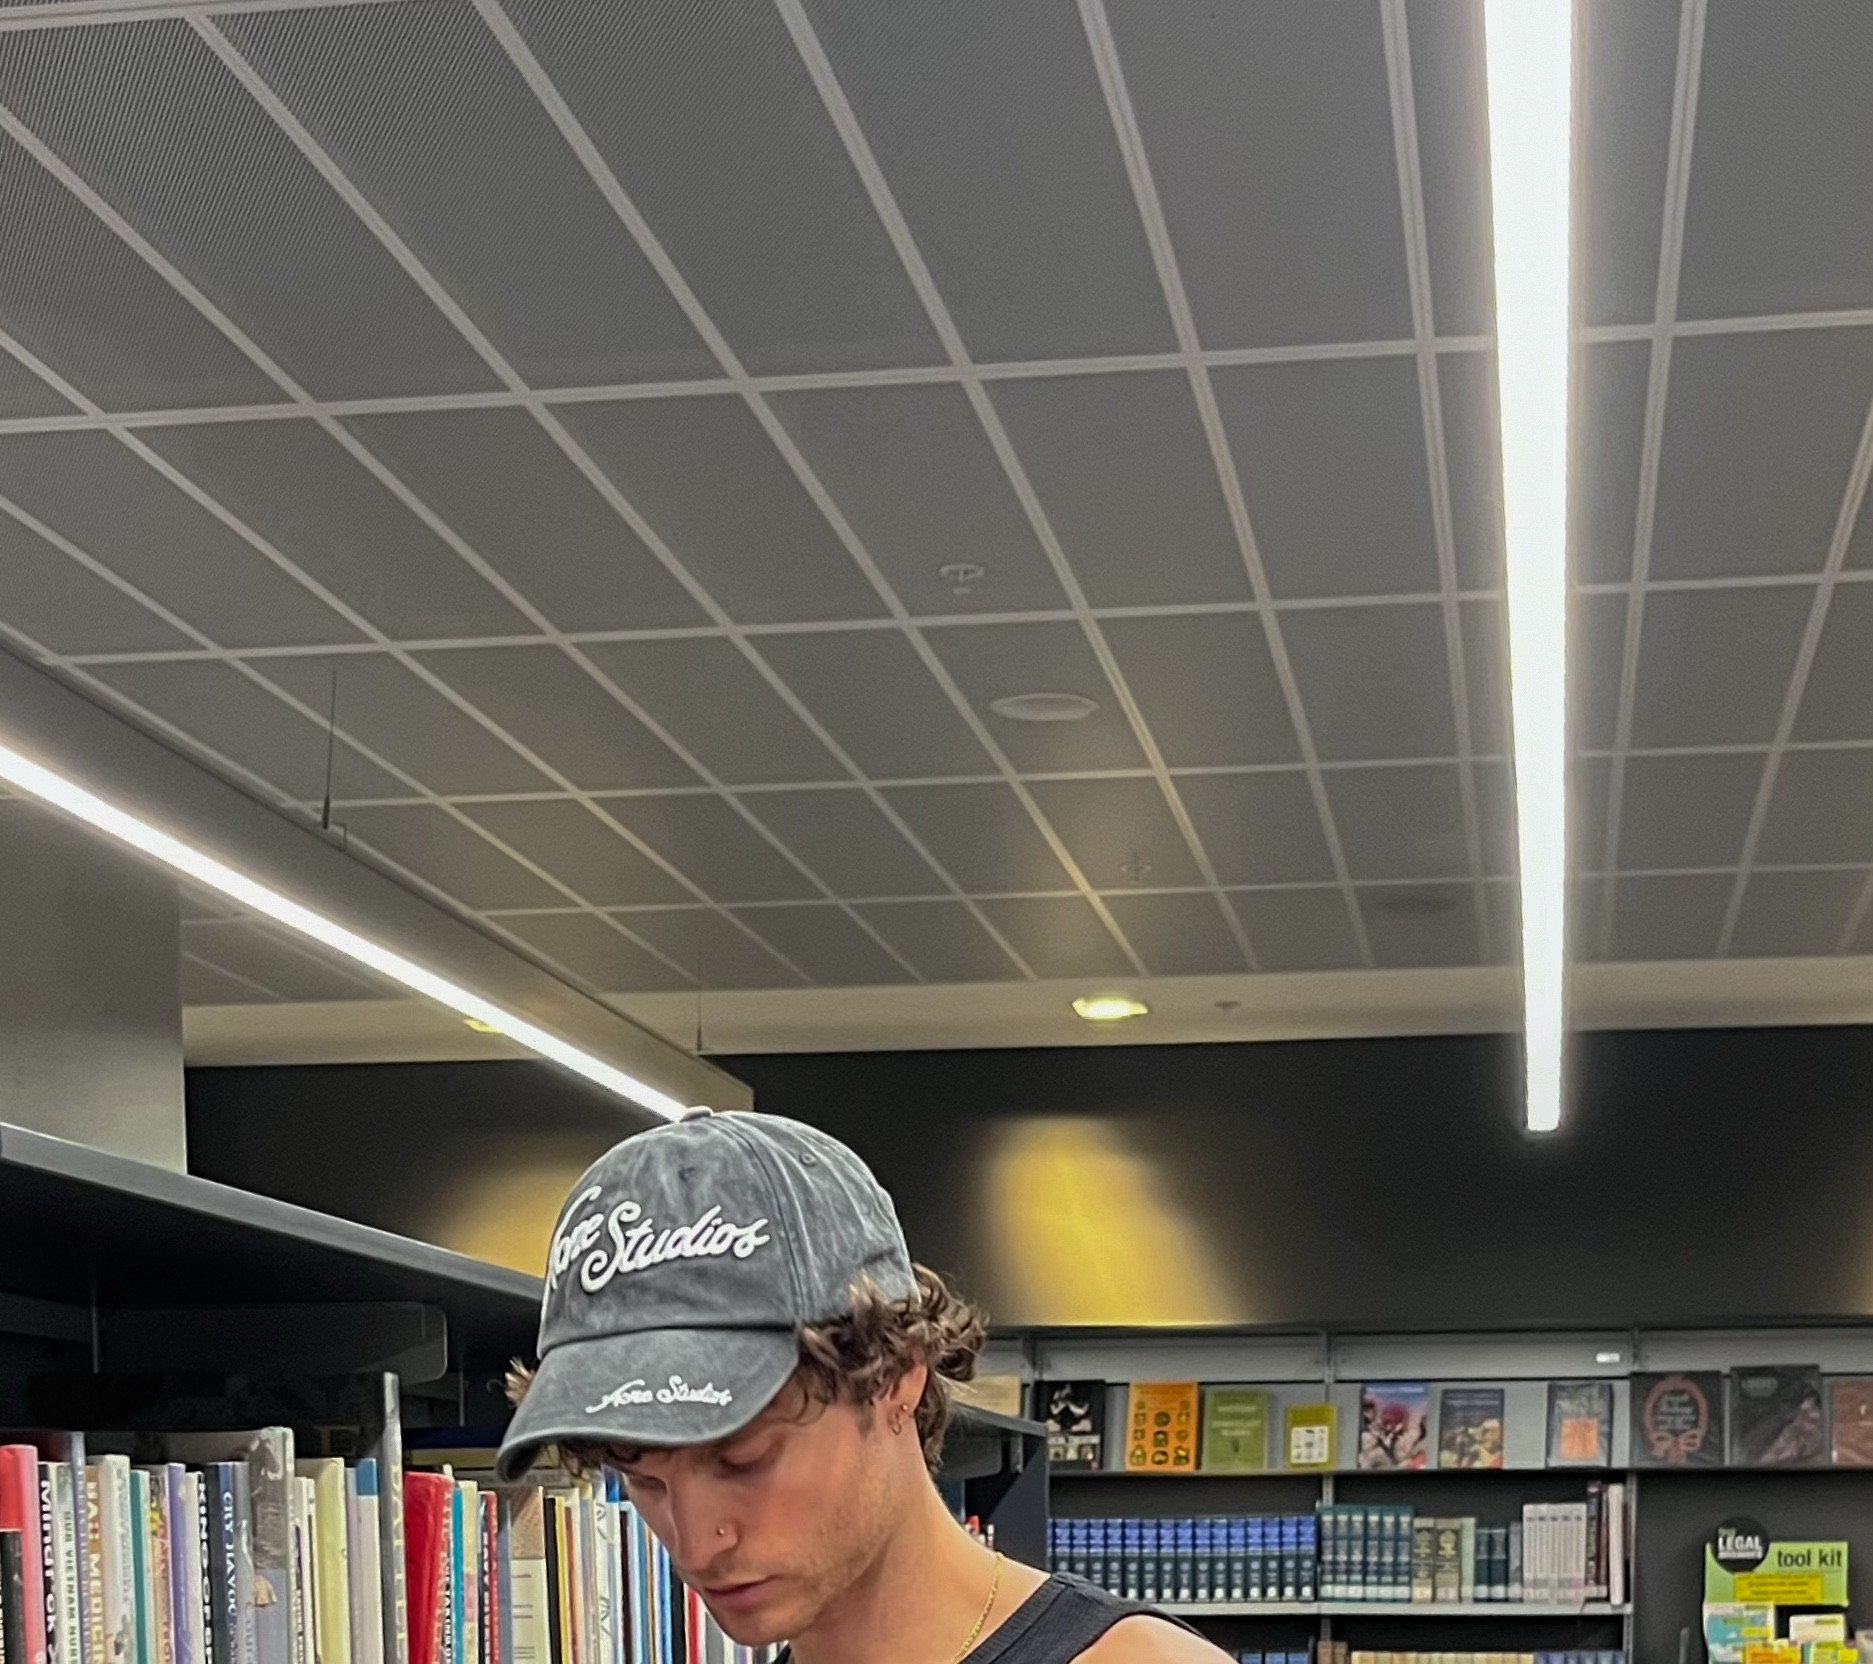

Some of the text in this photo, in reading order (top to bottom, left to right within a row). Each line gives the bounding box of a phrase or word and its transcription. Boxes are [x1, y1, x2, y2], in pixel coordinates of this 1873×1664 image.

[581, 1201, 770, 1292] Studios
[63, 1511, 72, 1543] OUR
[1777, 1548, 1843, 1568] tool kit
[65, 1550, 76, 1617] VIETNAM
